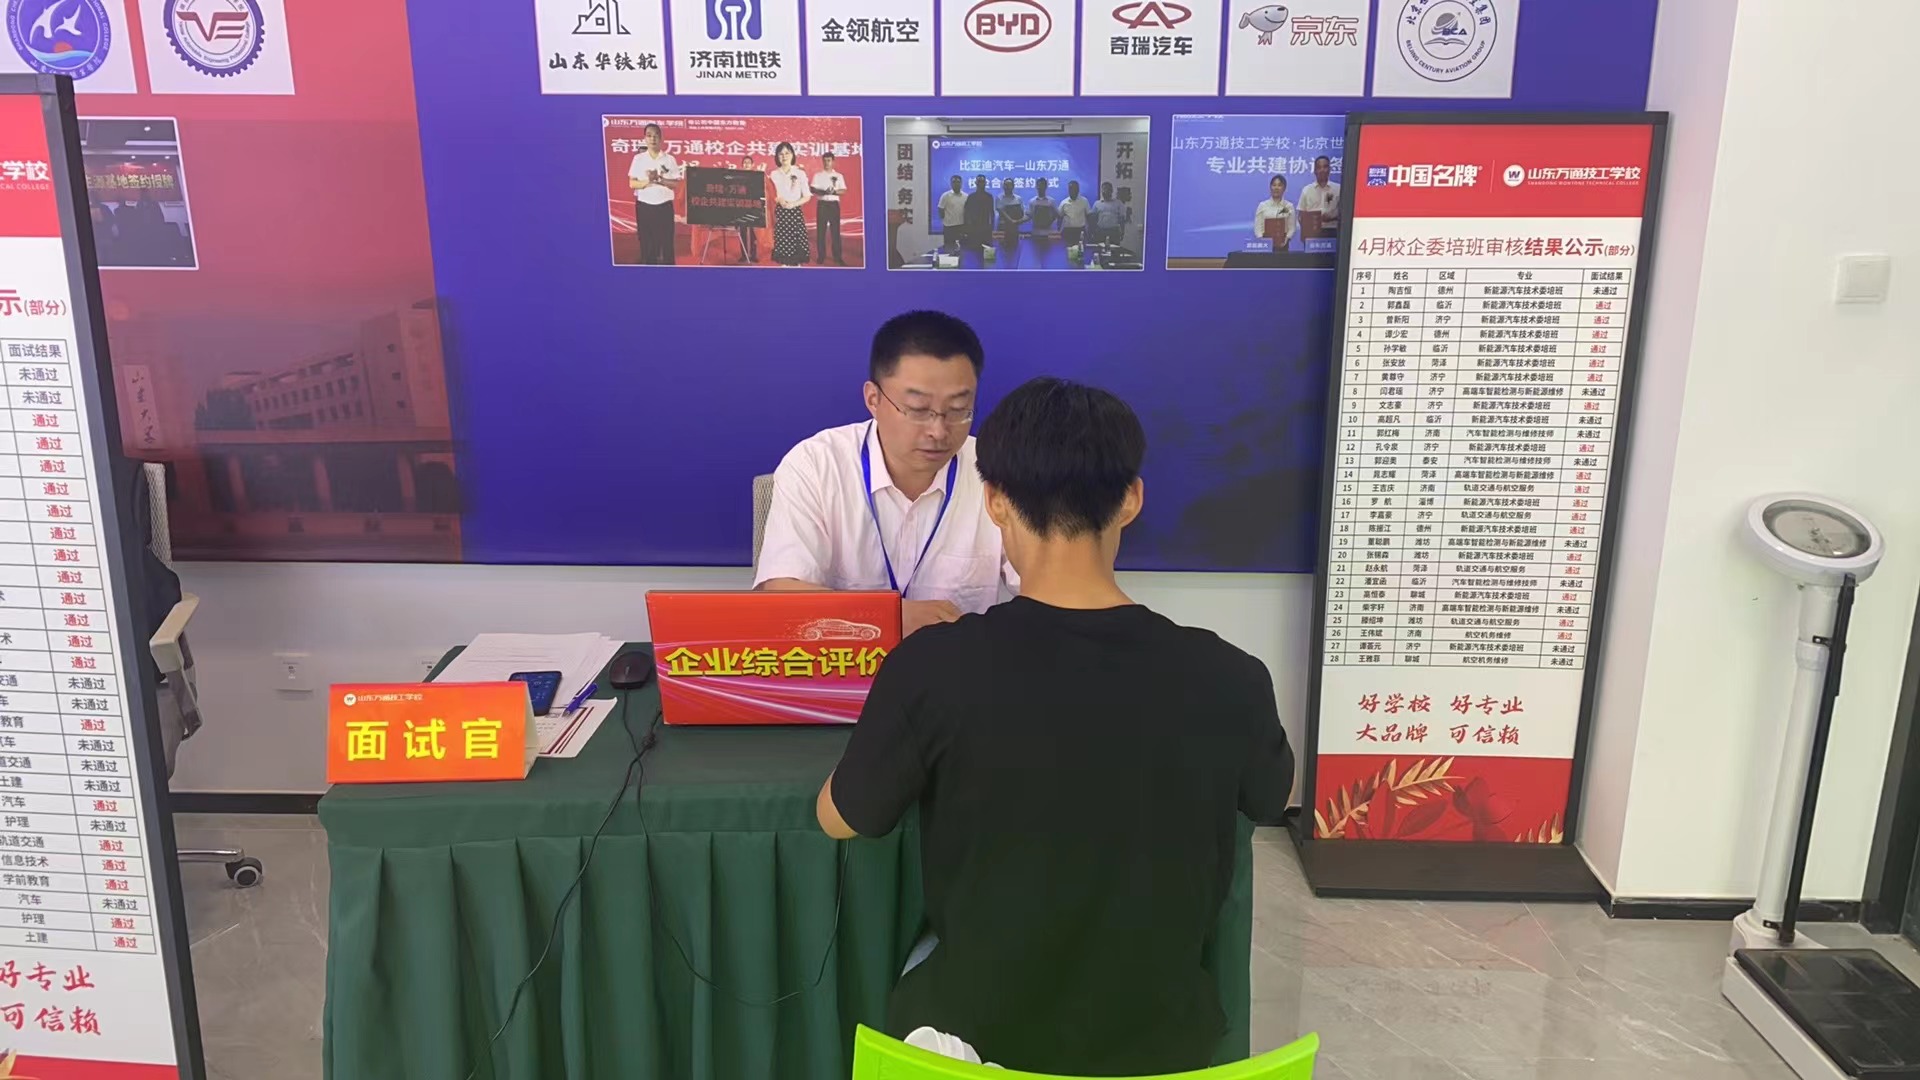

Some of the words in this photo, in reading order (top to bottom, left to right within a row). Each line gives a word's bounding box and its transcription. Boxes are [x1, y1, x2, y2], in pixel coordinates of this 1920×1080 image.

[821, 18, 920, 43] 金领航空
[976, 13, 1040, 35] BYD
[1290, 16, 1359, 46] 京东
[1110, 36, 1193, 56] 奇瑞汽车
[690, 50, 782, 69] 济南地铁
[1405, 40, 1420, 61] BEIJING
[1418, 59, 1443, 73] CENTURY
[1445, 59, 1472, 74] AVIATION
[1471, 40, 1485, 61] GROUP
[696, 71, 732, 79] JINAN
[735, 71, 777, 79] METRO
[1388, 164, 1478, 187] 中国名牌
[1528, 166, 1641, 180] 山东万通技工学校
[1355, 270, 1372, 281] 序号
[1392, 270, 1409, 281] 姓名
[1438, 270, 1456, 281] 区域
[1515, 270, 1533, 281] 专业
[1590, 270, 1623, 281] 面试结果
[1436, 285, 1454, 295] 德州
[1483, 285, 1564, 296] 新能源汽车技术委培班
[1592, 285, 1618, 296] 未通过
[1481, 299, 1562, 310] 新能源汽车技术委培班
[1594, 300, 1612, 310] 通过
[1434, 314, 1452, 325] 济宁
[1480, 314, 1560, 324] 新能源汽车技术委培班
[1593, 314, 1610, 325] 通过
[1478, 329, 1559, 339] 新能源汽车技术委培班
[1590, 329, 1609, 340] 通过
[8, 343, 61, 357] 面试结果
[1477, 343, 1558, 353] 新能源汽车技术委培班
[1589, 343, 1607, 354] 通过
[1476, 357, 1556, 368] 新能源汽车技术委培班
[1587, 358, 1605, 368] 通过
[18, 367, 58, 381] 未通过
[1474, 371, 1554, 382] 新能源汽车技术委培班
[21, 390, 62, 404] 未通过
[1580, 386, 1606, 397] 未通过
[1472, 400, 1551, 410] 新能源汽车技术委培班
[1582, 401, 1600, 411] 通过
[32, 414, 59, 427] 通过
[1470, 414, 1550, 424] 新能源汽车技术委培班
[1577, 415, 1603, 425] 未通过
[1424, 427, 1441, 438] 济南
[1576, 429, 1601, 439] 未通过
[35, 436, 62, 450] 通过
[1467, 442, 1547, 452] 新能源汽车技术委培班
[39, 459, 66, 473] 通过
[1421, 455, 1438, 465] 泰安
[1572, 457, 1598, 467] 未通过
[42, 482, 69, 495] 通过
[1462, 483, 1535, 492] 轨道交通与航空服务
[1462, 496, 1540, 507] 新能源汽车技术委培班
[1571, 498, 1589, 508] 通过
[46, 504, 72, 518] 通过
[1460, 510, 1532, 520] 轨道交通与航空服务
[49, 526, 76, 540] 通过
[1459, 524, 1538, 534] 新能源汽车技术委培班
[1563, 538, 1588, 549] 未通过
[53, 548, 79, 561] 通过
[1457, 550, 1535, 561] 新能源汽车技术委培班
[1454, 564, 1526, 574] 轨道交通与航空服务
[56, 570, 83, 583] 通过
[1559, 578, 1583, 588] 未通过
[60, 592, 86, 605] 通过
[1453, 590, 1530, 601] 新能源汽车技术委培班
[1555, 605, 1580, 615] 未通过
[63, 613, 89, 626] 通过
[1449, 617, 1520, 626] 轨道交通与航空服务
[67, 634, 93, 648] 通过
[1448, 642, 1525, 652] 新能源汽车技术委培班
[1551, 644, 1575, 654] 未通过
[70, 656, 96, 669] 通过
[1550, 656, 1574, 667] 未通过
[67, 676, 105, 690] 未通过
[70, 697, 108, 710] 未通过
[1358, 693, 1431, 714] 好学校
[1450, 694, 1524, 715] 好专业
[80, 718, 105, 731] 通过
[345, 717, 503, 761] 面试官
[1356, 723, 1428, 743] 大品牌
[1449, 724, 1519, 745] 可信赖
[77, 739, 114, 752] 未通过
[80, 759, 118, 772] 未通过
[83, 779, 120, 792] 未通过
[1, 795, 25, 807] 汽车
[92, 799, 117, 812] 通过
[4, 815, 29, 827] 护理
[89, 819, 126, 832] 未通过
[98, 839, 123, 852] 通过
[1, 854, 48, 867] 信息技术
[102, 859, 126, 871] 通过
[3, 873, 49, 886] 学前教育
[104, 878, 128, 890] 通过
[18, 893, 41, 905] 汽车
[101, 898, 138, 910] 未通过
[21, 912, 45, 924] 护理
[110, 917, 134, 929] 通过
[25, 931, 48, 943] 土建
[113, 936, 137, 948] 通过
[0, 960, 95, 991] 好专业
[0, 1003, 101, 1035] 可信赖
